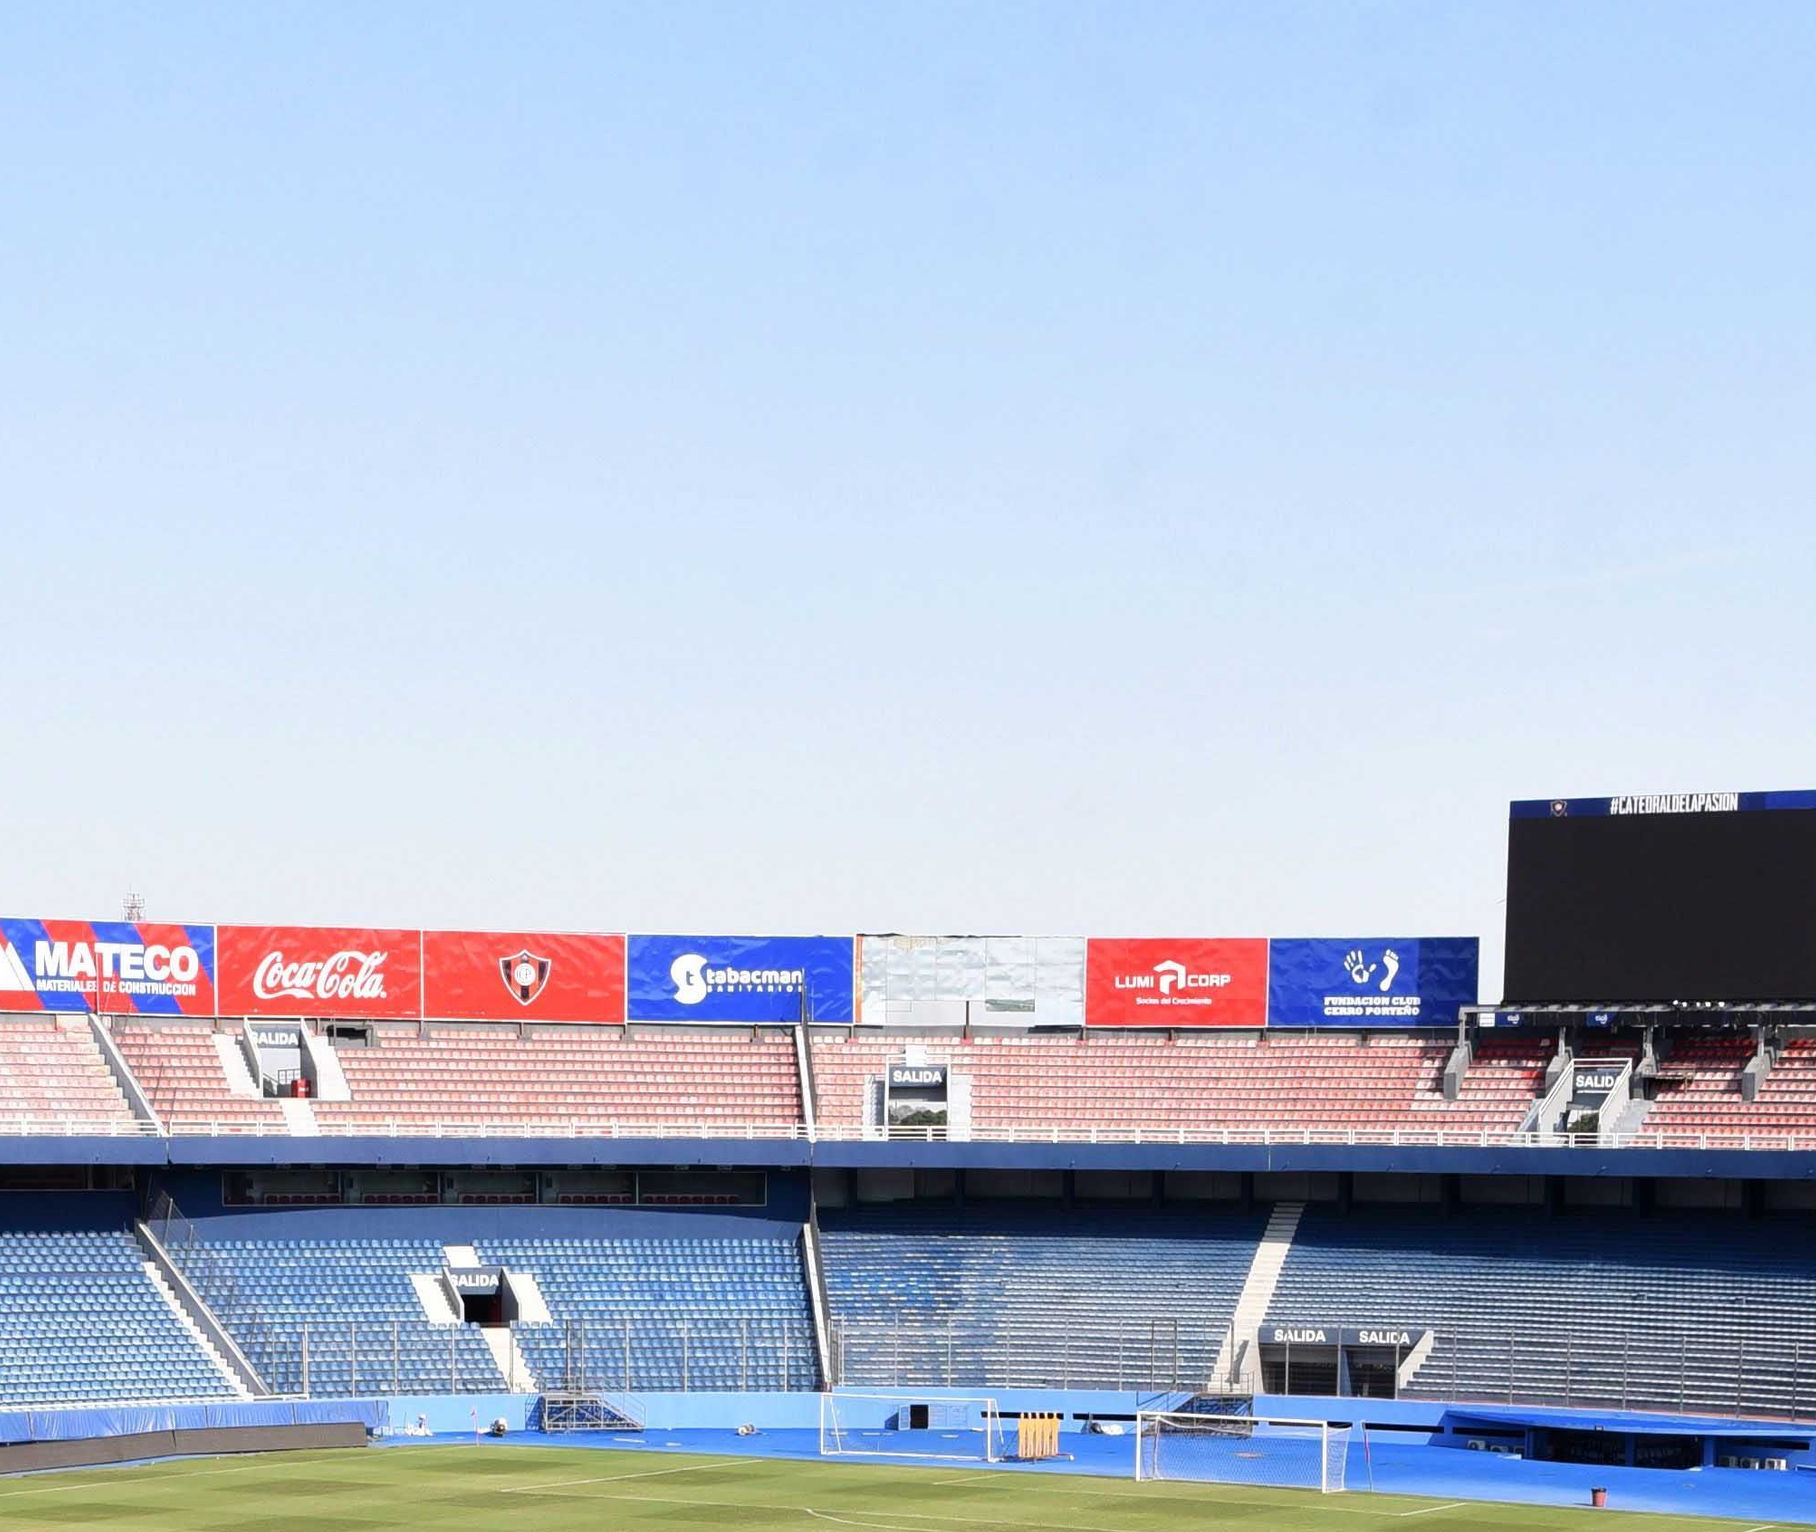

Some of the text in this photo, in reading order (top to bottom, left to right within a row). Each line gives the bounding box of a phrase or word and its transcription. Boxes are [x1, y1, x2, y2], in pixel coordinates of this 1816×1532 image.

[1610, 793, 1739, 815] #CATEDRALDELAPASION
[35, 940, 199, 981] MATECO
[253, 951, 388, 999] Coca-Cola
[706, 967, 802, 984] tabacman
[1114, 974, 1231, 989] LUMI CORP
[103, 980, 117, 992] DE
[1391, 996, 1421, 1006] CLUB
[1324, 1005, 1420, 1016] CERRO PORTEÑO
[893, 1070, 943, 1083] SALIDA
[1274, 1329, 1326, 1342] SALIDA
[1359, 1331, 1410, 1344] SALIDA
